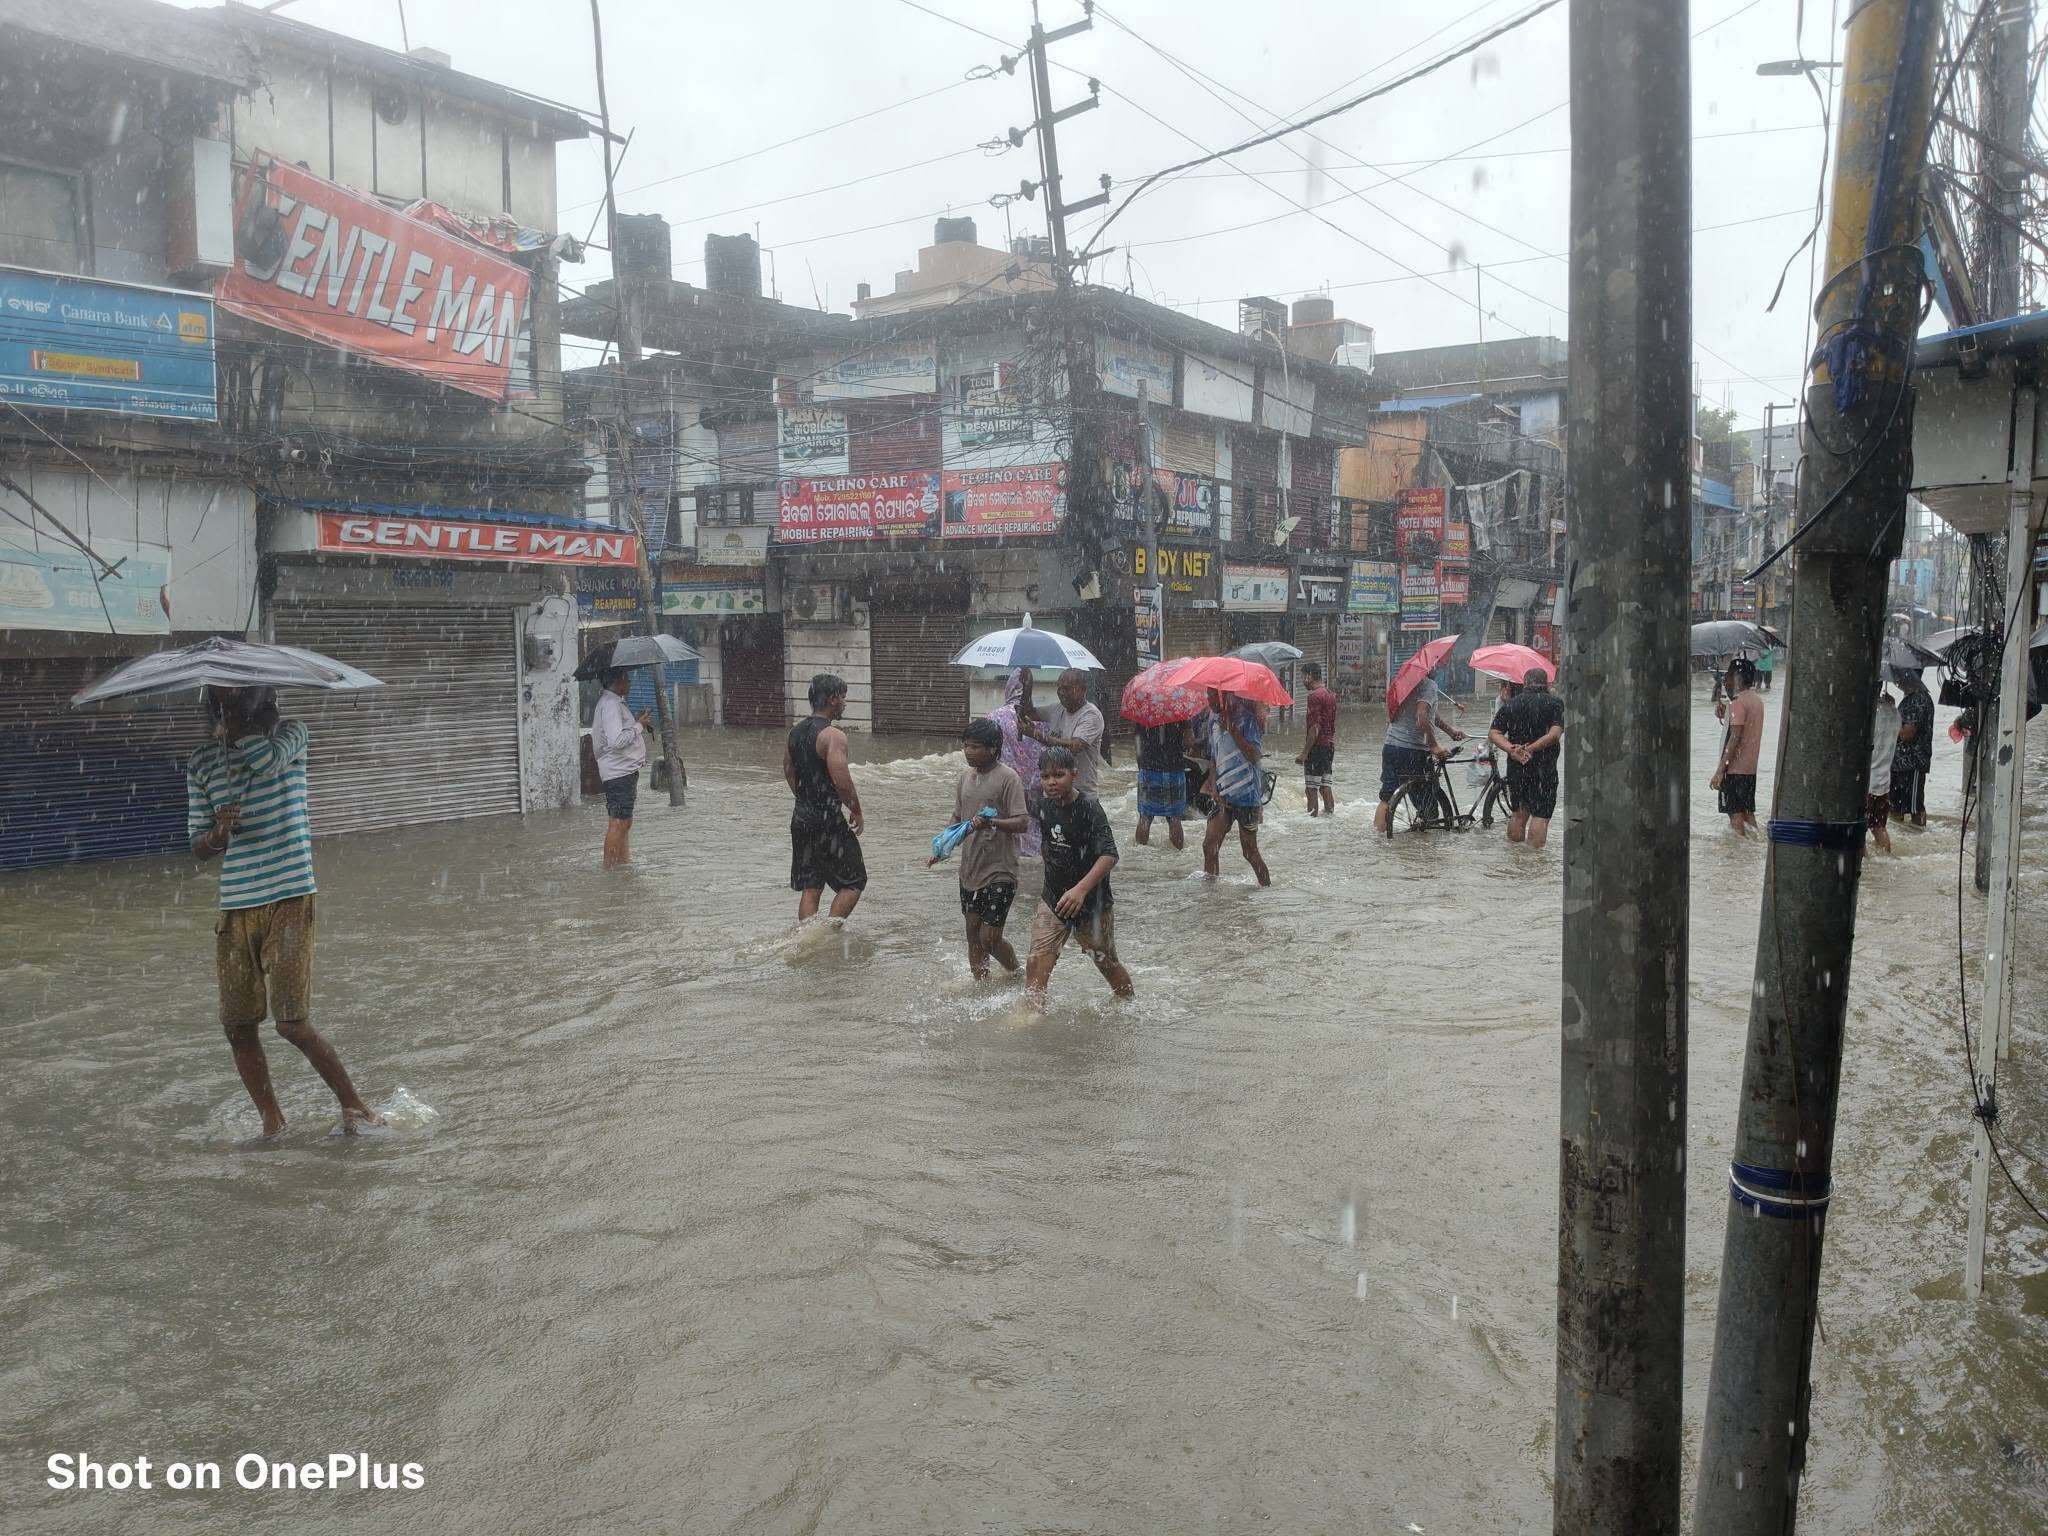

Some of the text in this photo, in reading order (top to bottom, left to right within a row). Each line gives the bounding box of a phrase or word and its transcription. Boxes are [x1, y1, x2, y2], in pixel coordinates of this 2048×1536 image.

[61, 304, 149, 328] Canara Bank
[969, 376, 992, 387] TECH
[811, 475, 908, 493] TECHNO CARE
[960, 468, 1052, 485] TECHNO CARE
[781, 525, 873, 540] MOBILE REPAIRING
[946, 521, 1057, 536] ADVANCE MOBILE REPAIRING CEN
[339, 519, 623, 560] GENTLE MAN
[1135, 547, 1211, 577] BDY NET
[575, 577, 615, 594] ADVANCE
[1311, 584, 1337, 605] PRINCE
